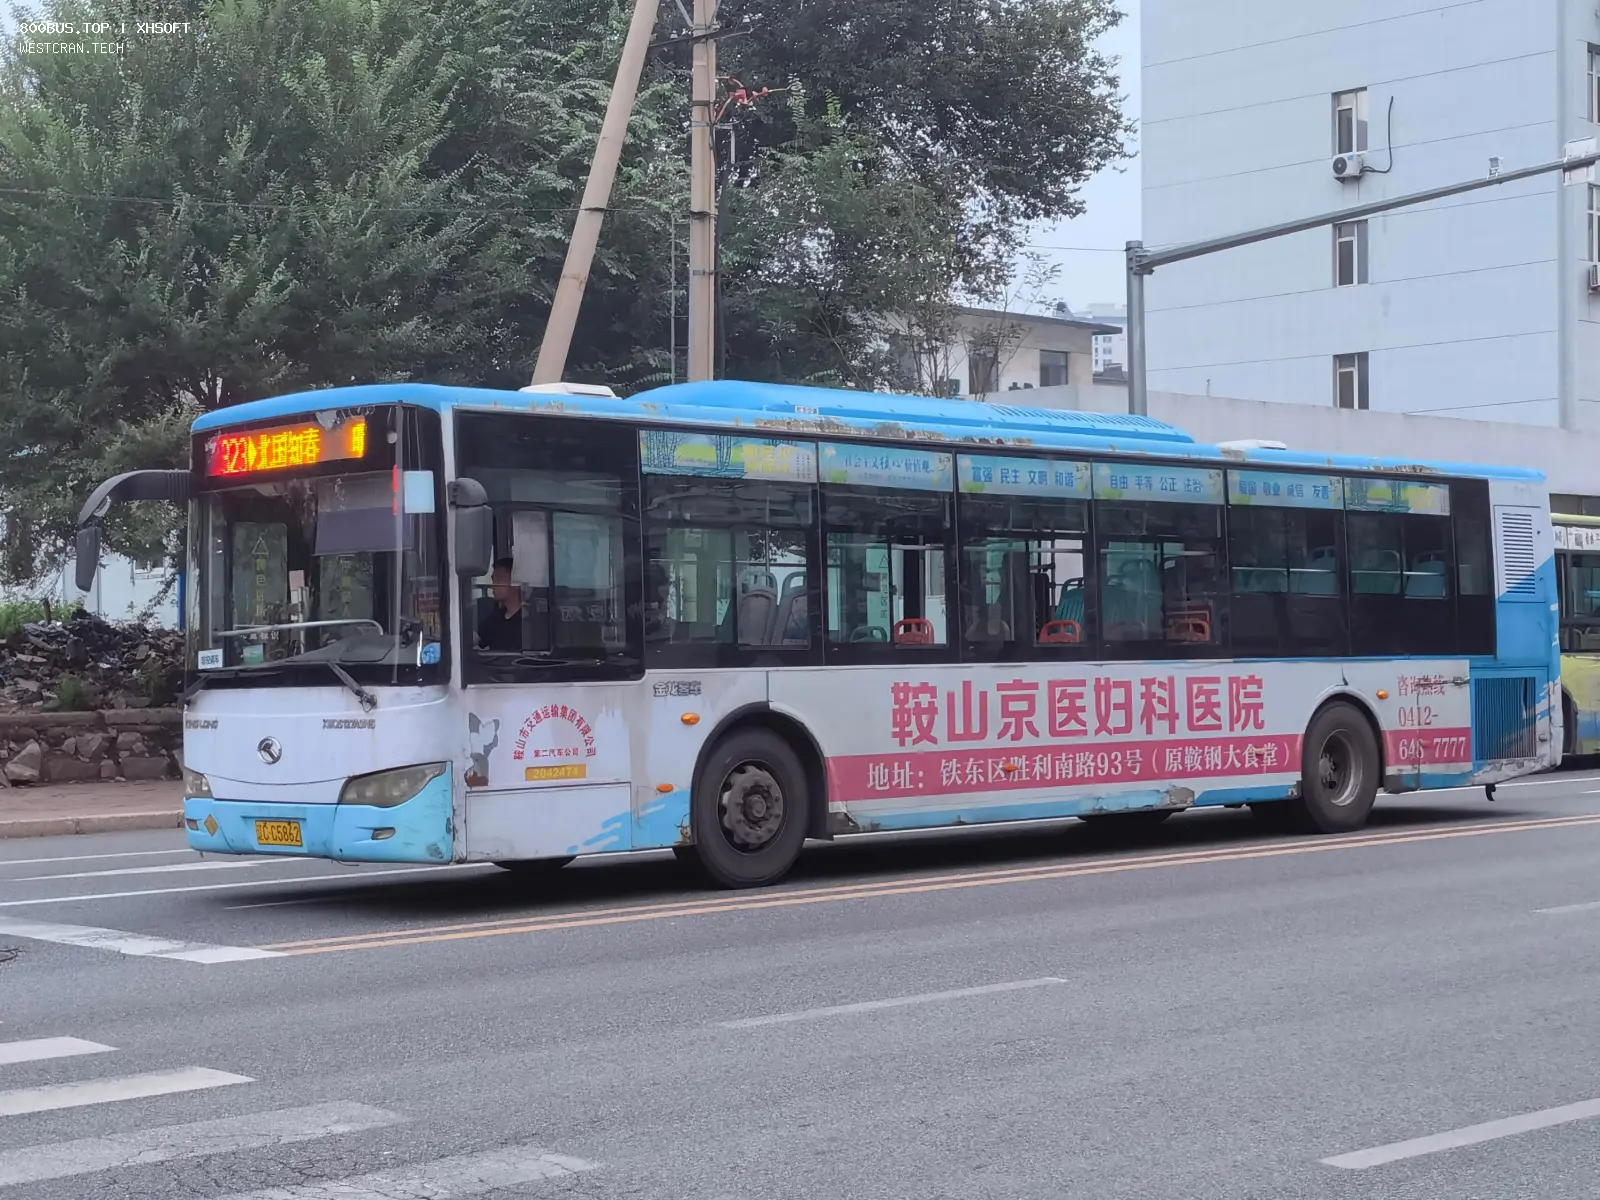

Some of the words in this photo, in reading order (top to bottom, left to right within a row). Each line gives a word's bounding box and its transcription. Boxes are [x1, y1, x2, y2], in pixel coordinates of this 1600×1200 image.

[972, 466, 993, 483] 富强
[1001, 468, 1020, 484] 民主
[1027, 470, 1048, 486] 文明
[1055, 471, 1074, 487] 和谐
[1110, 474, 1128, 490] 自由
[1135, 475, 1153, 491] 平等
[1160, 476, 1178, 492] 公正
[1184, 477, 1203, 493] 法治
[653, 681, 702, 697] 金龙客车
[890, 674, 1265, 747] 鞍山京医妇科医院
[1398, 706, 1439, 727] 0412-
[513, 703, 596, 760] 鞍山市交通运输集团有限公司
[533, 748, 579, 759] 第二汽车公司
